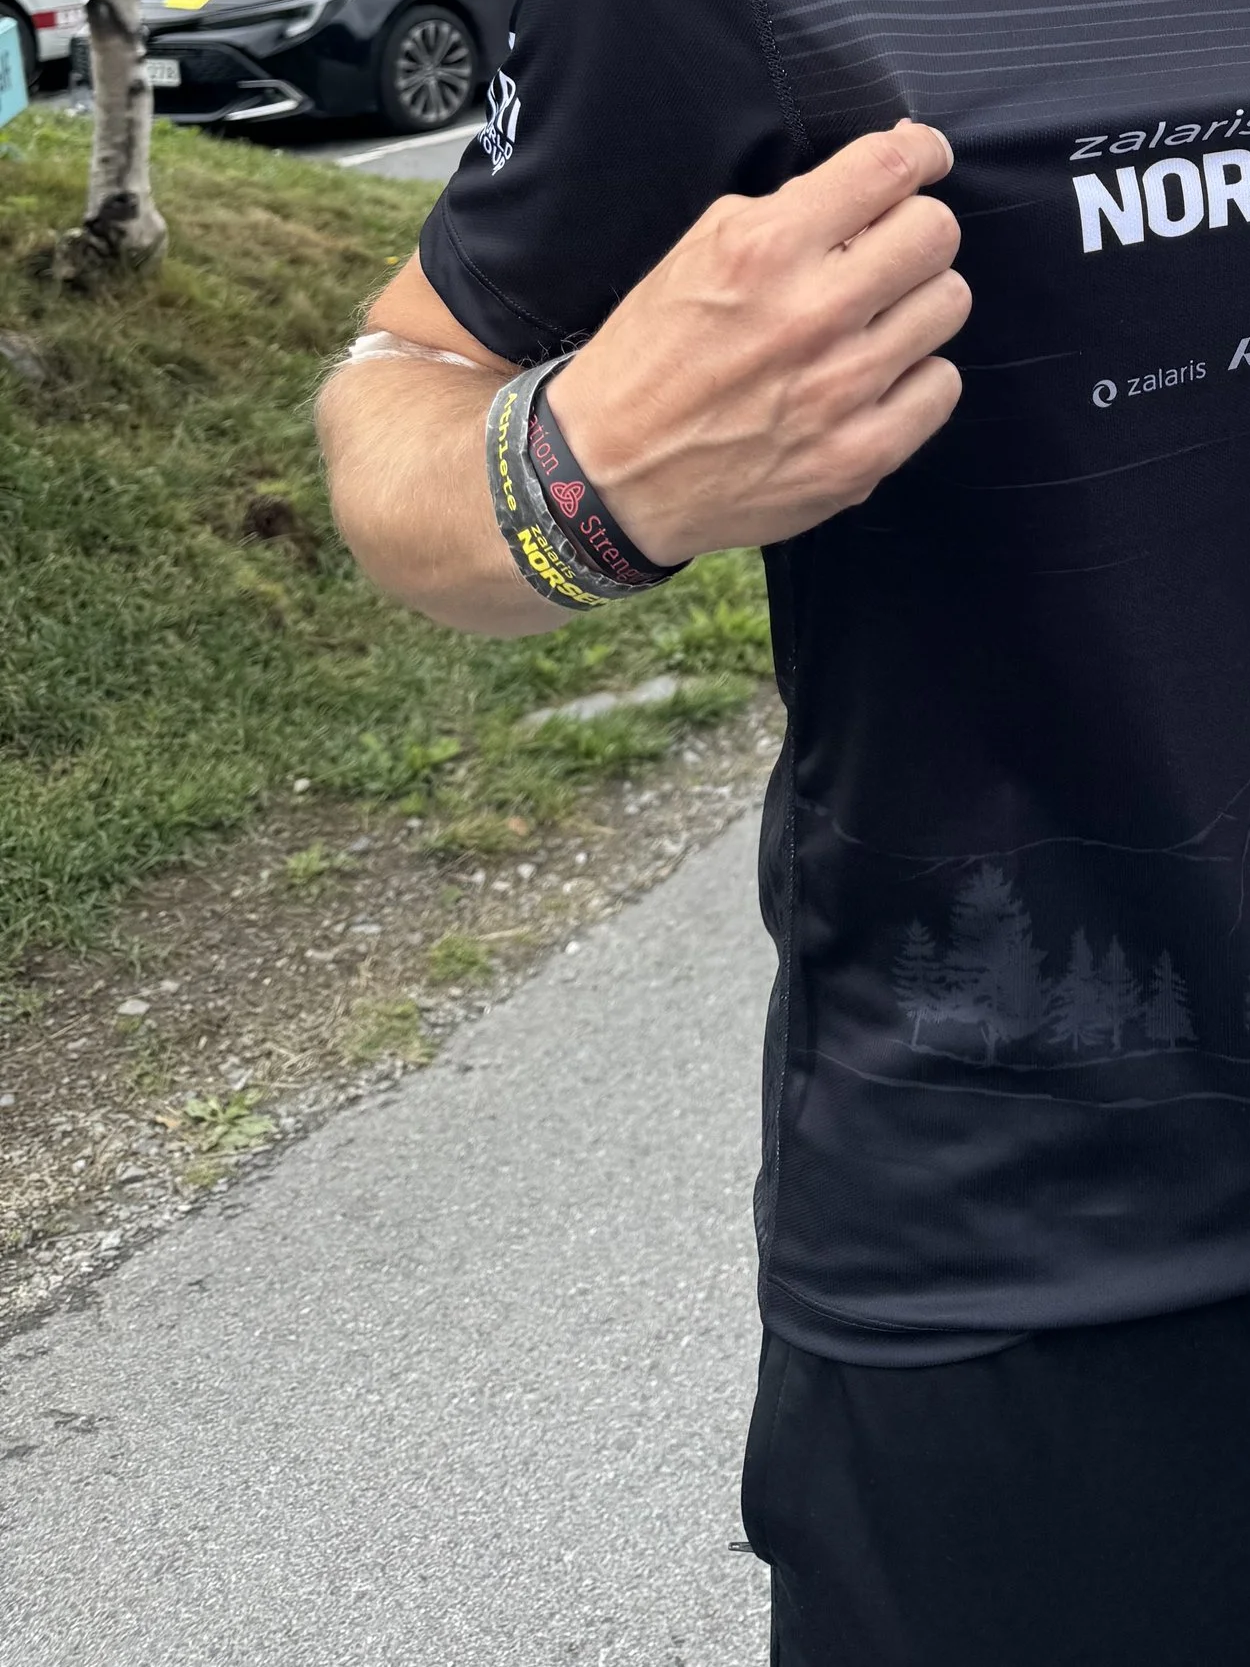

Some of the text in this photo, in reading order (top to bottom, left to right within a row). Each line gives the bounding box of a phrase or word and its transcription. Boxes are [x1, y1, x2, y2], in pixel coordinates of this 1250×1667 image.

[1127, 359, 1207, 397] zalaris
[498, 391, 518, 512] Athlete
[527, 408, 648, 583] ation Streng
[530, 524, 576, 580] zalaris
